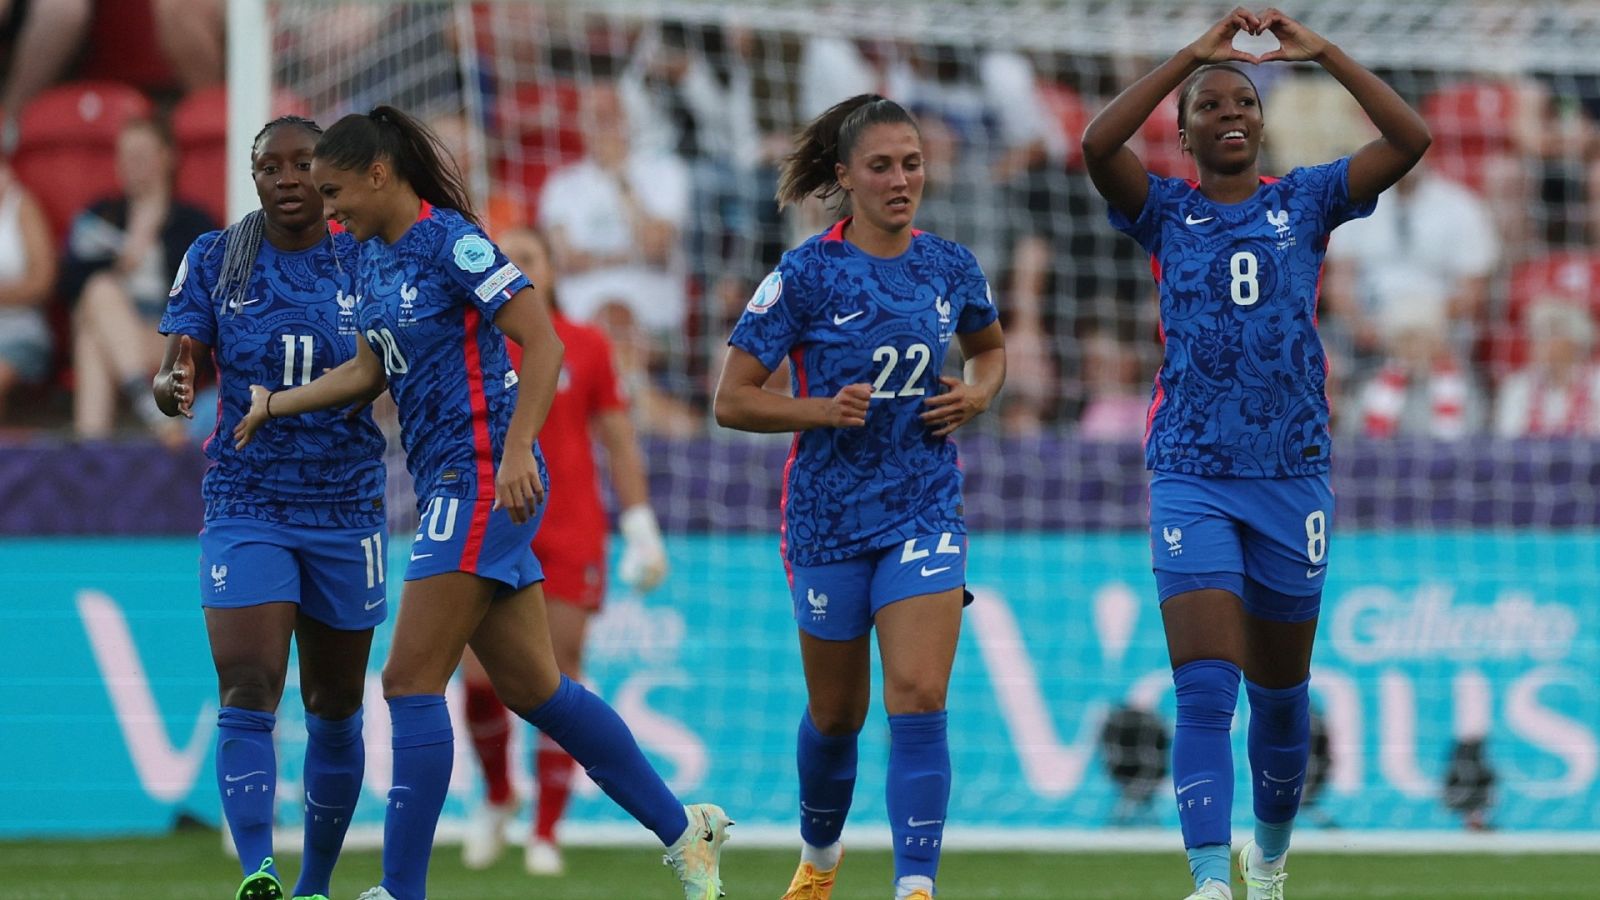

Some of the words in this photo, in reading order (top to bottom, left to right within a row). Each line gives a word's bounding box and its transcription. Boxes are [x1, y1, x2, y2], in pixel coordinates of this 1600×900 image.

[1230, 251, 1259, 305] 8
[281, 335, 313, 386] 11
[870, 344, 930, 399] 22
[361, 532, 384, 589] 11
[1305, 510, 1326, 563] 8
